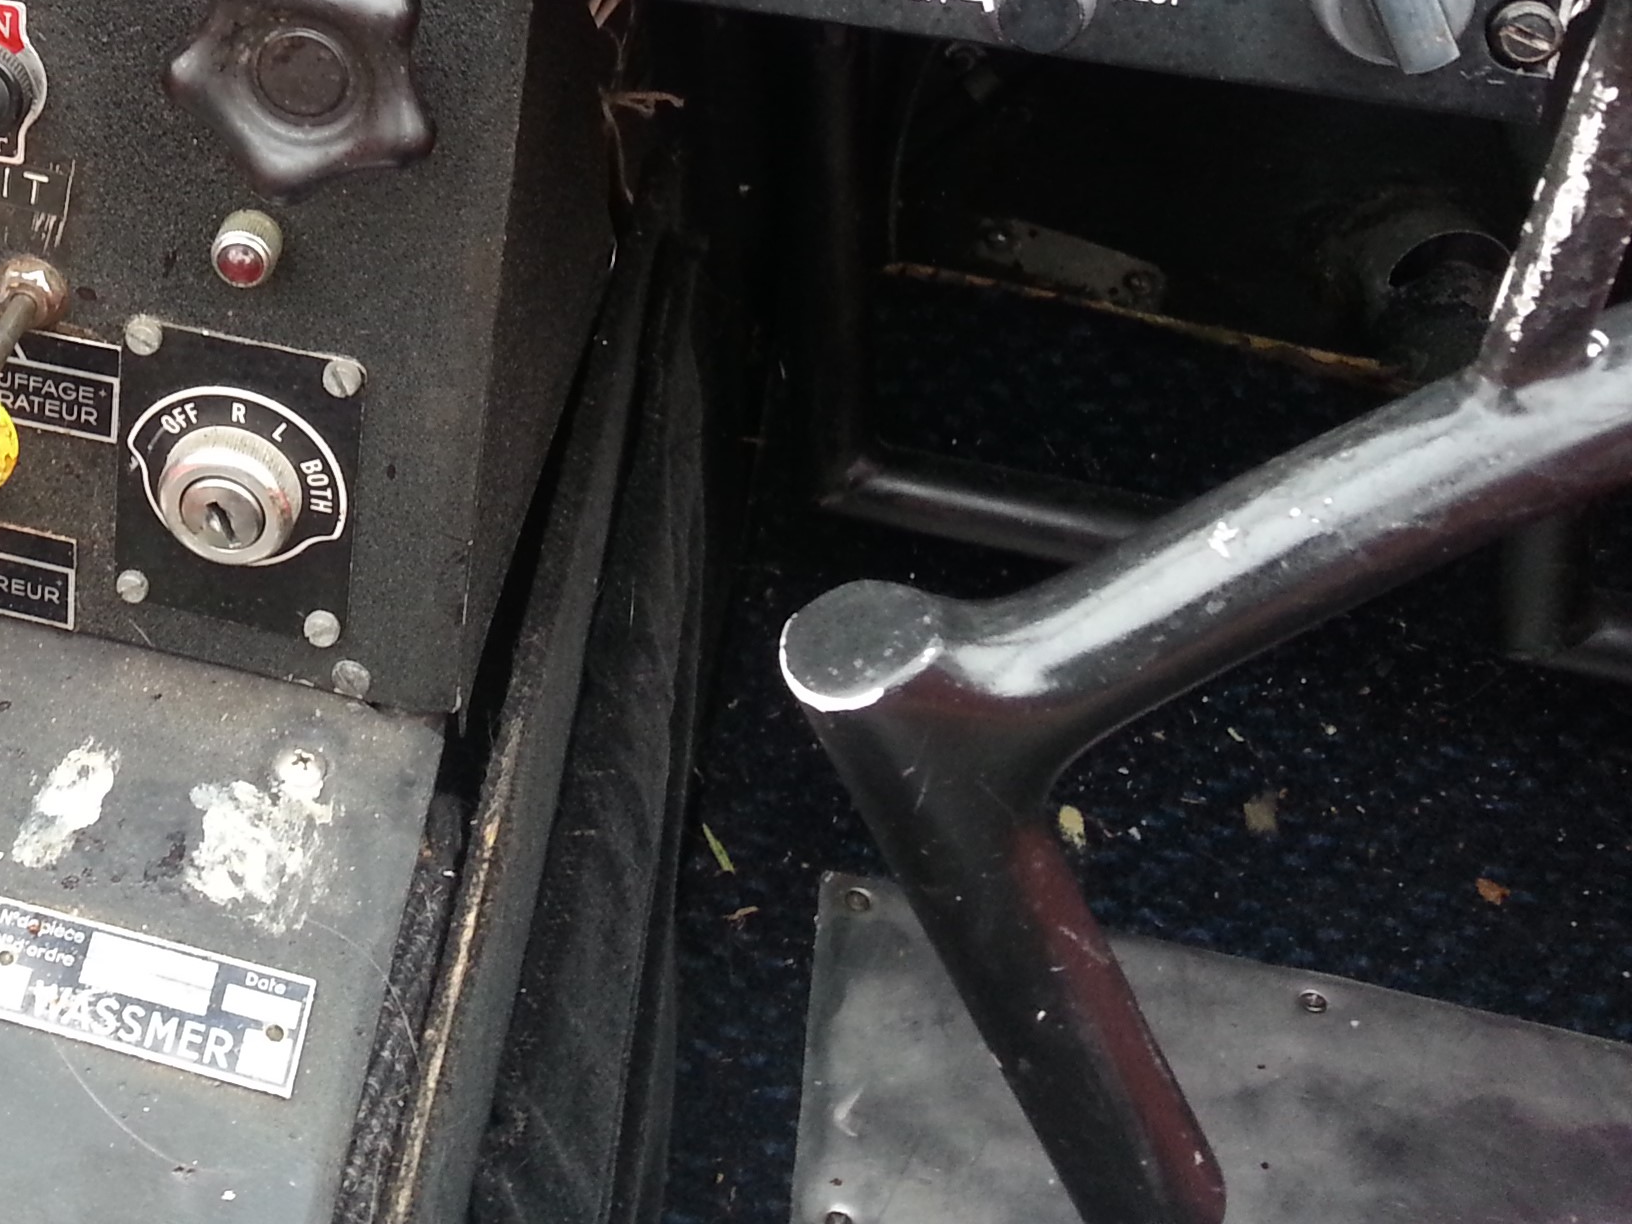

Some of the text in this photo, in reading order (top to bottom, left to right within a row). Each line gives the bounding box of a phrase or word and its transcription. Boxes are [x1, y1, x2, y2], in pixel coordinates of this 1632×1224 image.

[160, 402, 199, 434] OFF
[231, 402, 247, 424] R
[272, 422, 288, 443] L
[299, 458, 334, 514] BOTH
[244, 972, 287, 997] Date
[28, 979, 235, 1070] WASSMER
